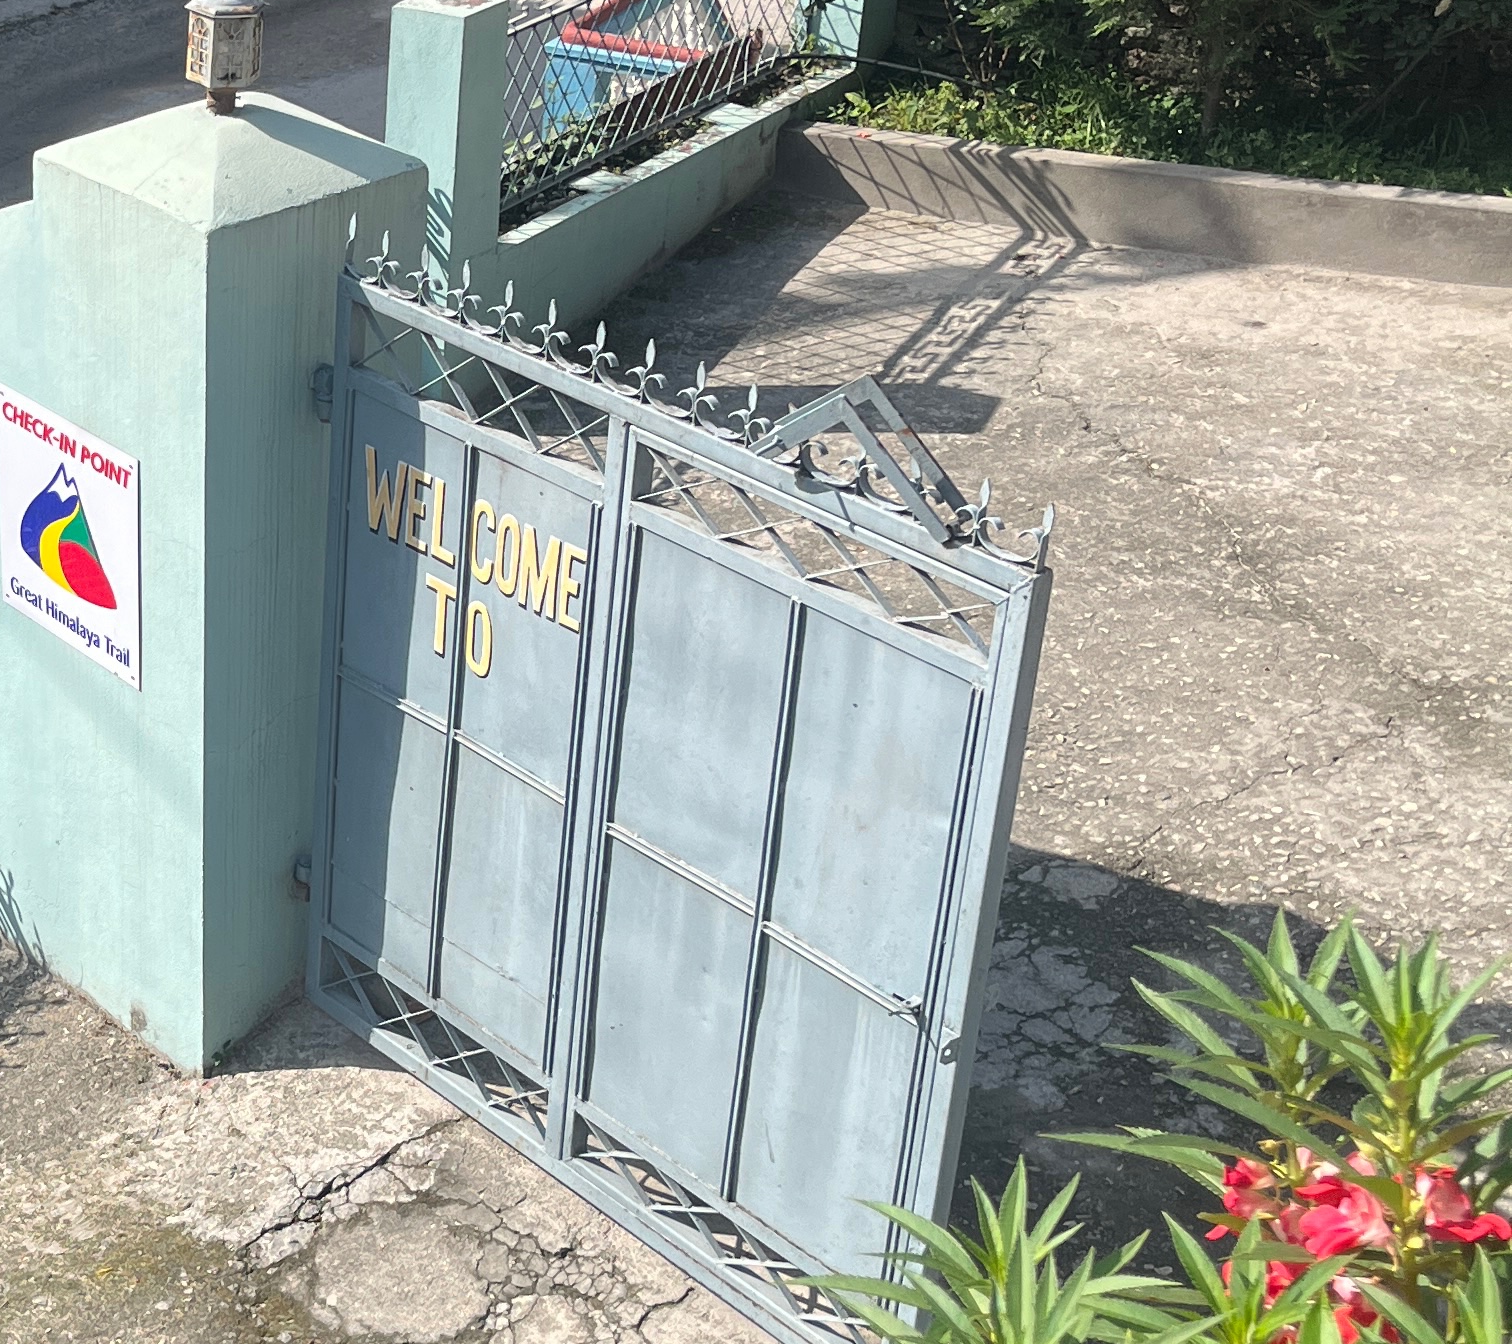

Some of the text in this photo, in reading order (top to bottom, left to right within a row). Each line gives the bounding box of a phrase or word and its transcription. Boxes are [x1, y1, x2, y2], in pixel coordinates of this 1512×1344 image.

[2, 401, 131, 489] CHECK-IN POINT
[10, 576, 130, 668] Great Himalaya Trail
[425, 572, 493, 678] TO
